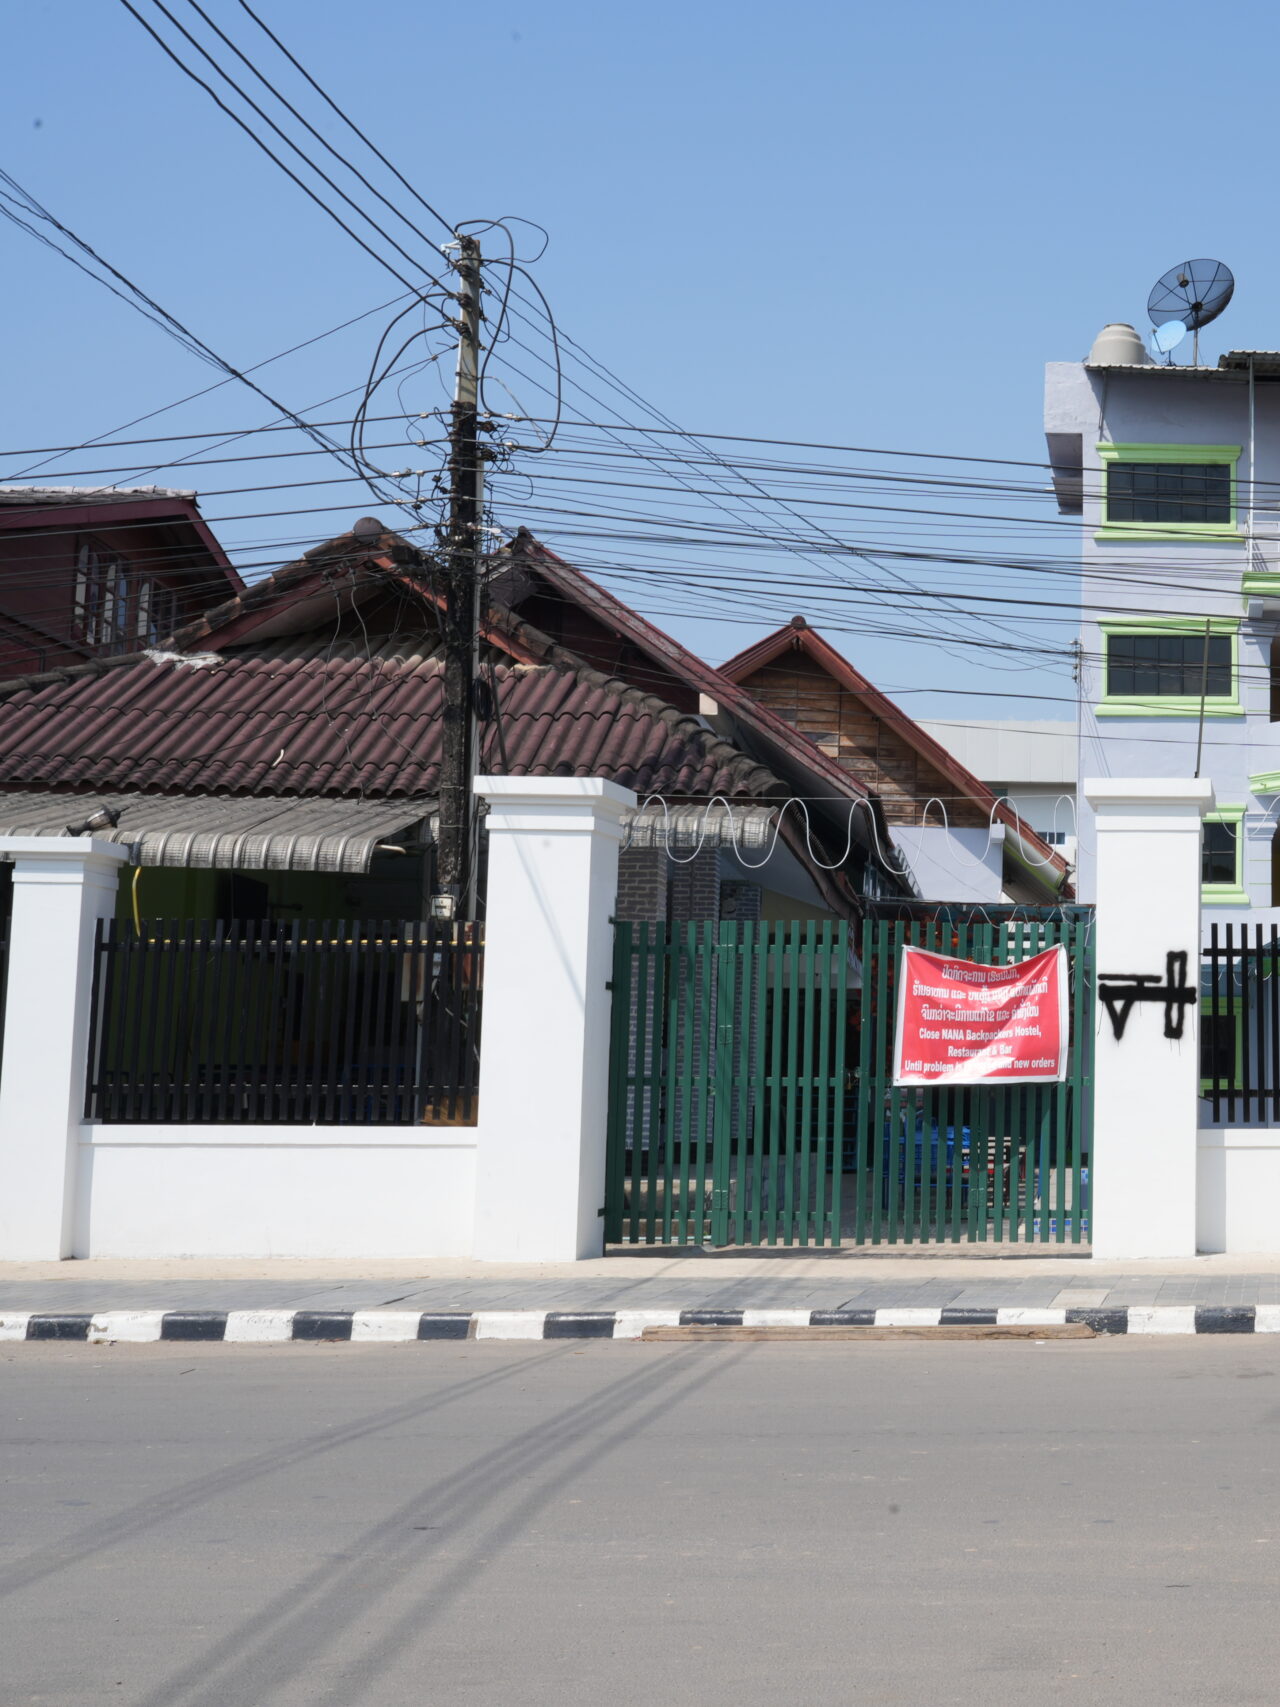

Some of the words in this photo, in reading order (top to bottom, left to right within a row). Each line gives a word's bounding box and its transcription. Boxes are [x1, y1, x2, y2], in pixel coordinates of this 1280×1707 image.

[919, 1028, 939, 1040] Close
[941, 1028, 964, 1041] NANA
[1015, 1025, 1041, 1038] Hostel,
[999, 1044, 1012, 1055] Bar
[905, 1060, 922, 1071] Until
[923, 1060, 954, 1074] problem
[1014, 1058, 1029, 1068] new
[1031, 1057, 1055, 1067] orders
